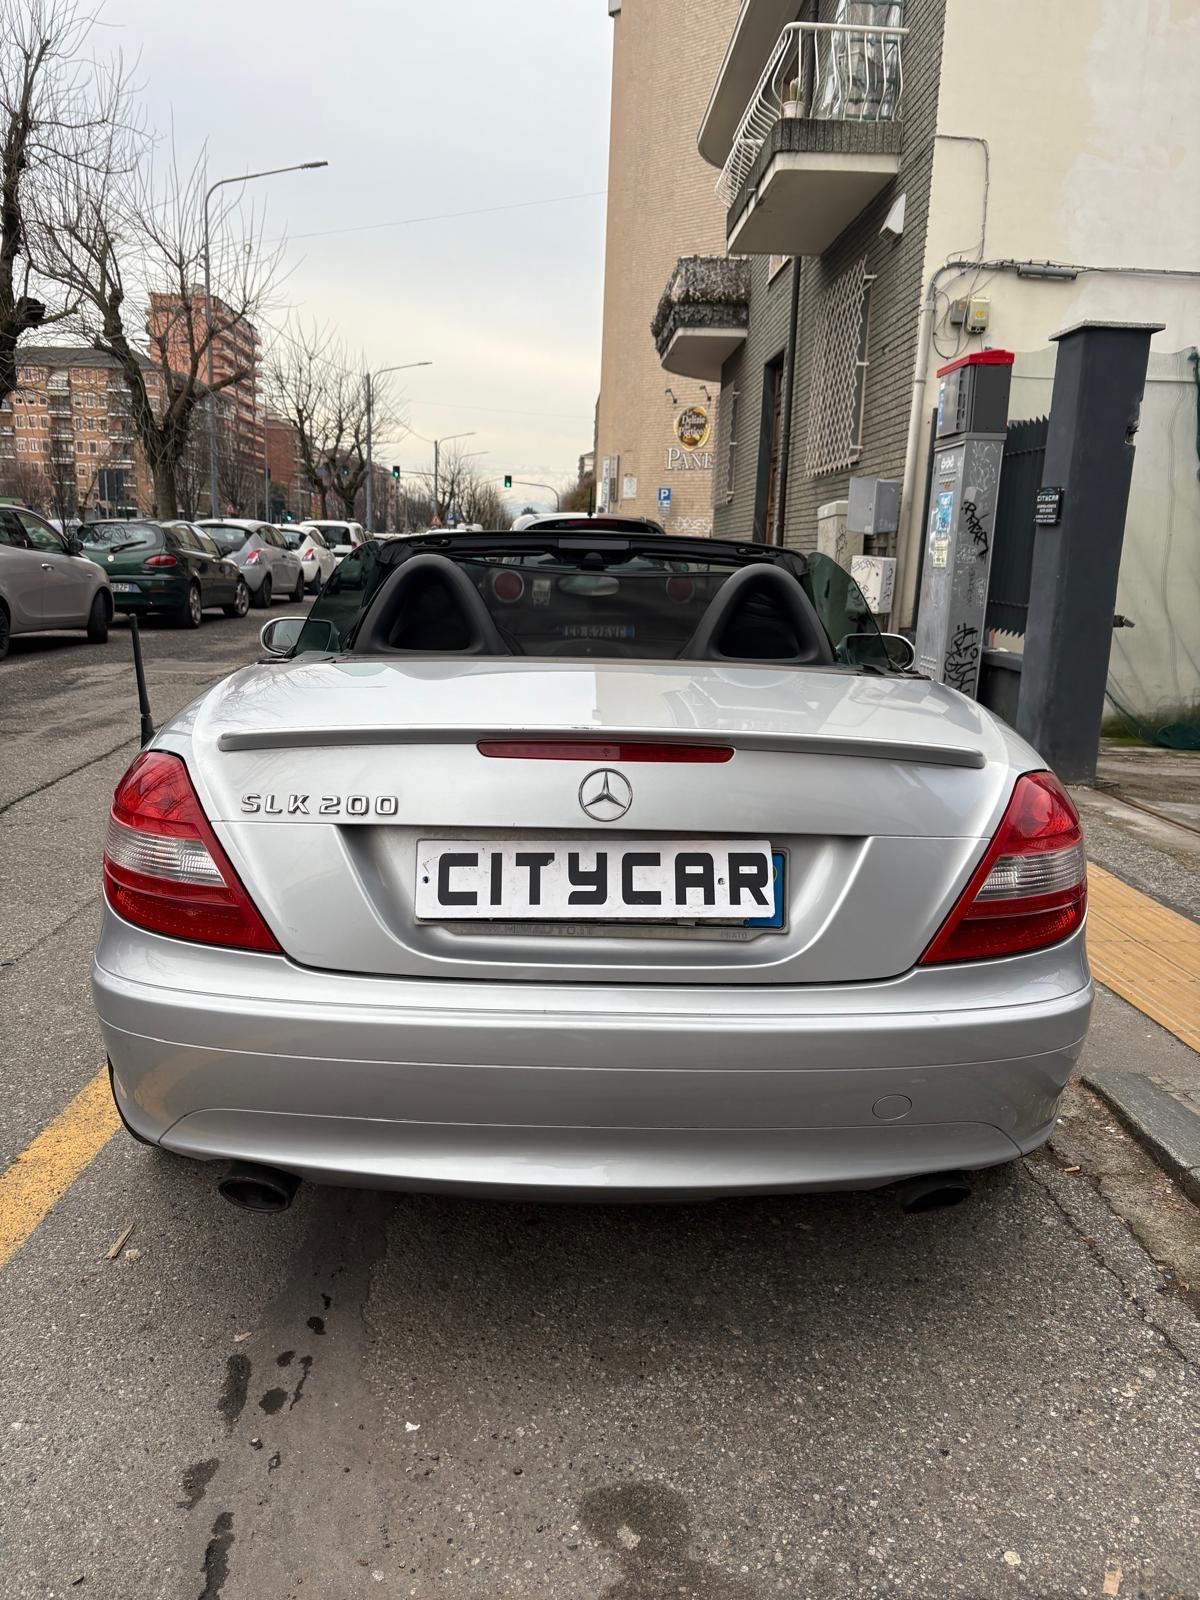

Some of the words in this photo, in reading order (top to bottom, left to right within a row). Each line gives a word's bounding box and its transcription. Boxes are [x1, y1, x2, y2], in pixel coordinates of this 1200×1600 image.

[682, 414, 706, 425] Delizie
[678, 427, 704, 436] Portico
[660, 489, 669, 500] P
[1036, 494, 1059, 502] CITYCAR
[240, 793, 311, 815] SLK
[318, 795, 399, 816] 200
[437, 851, 771, 906] CITYCAR
